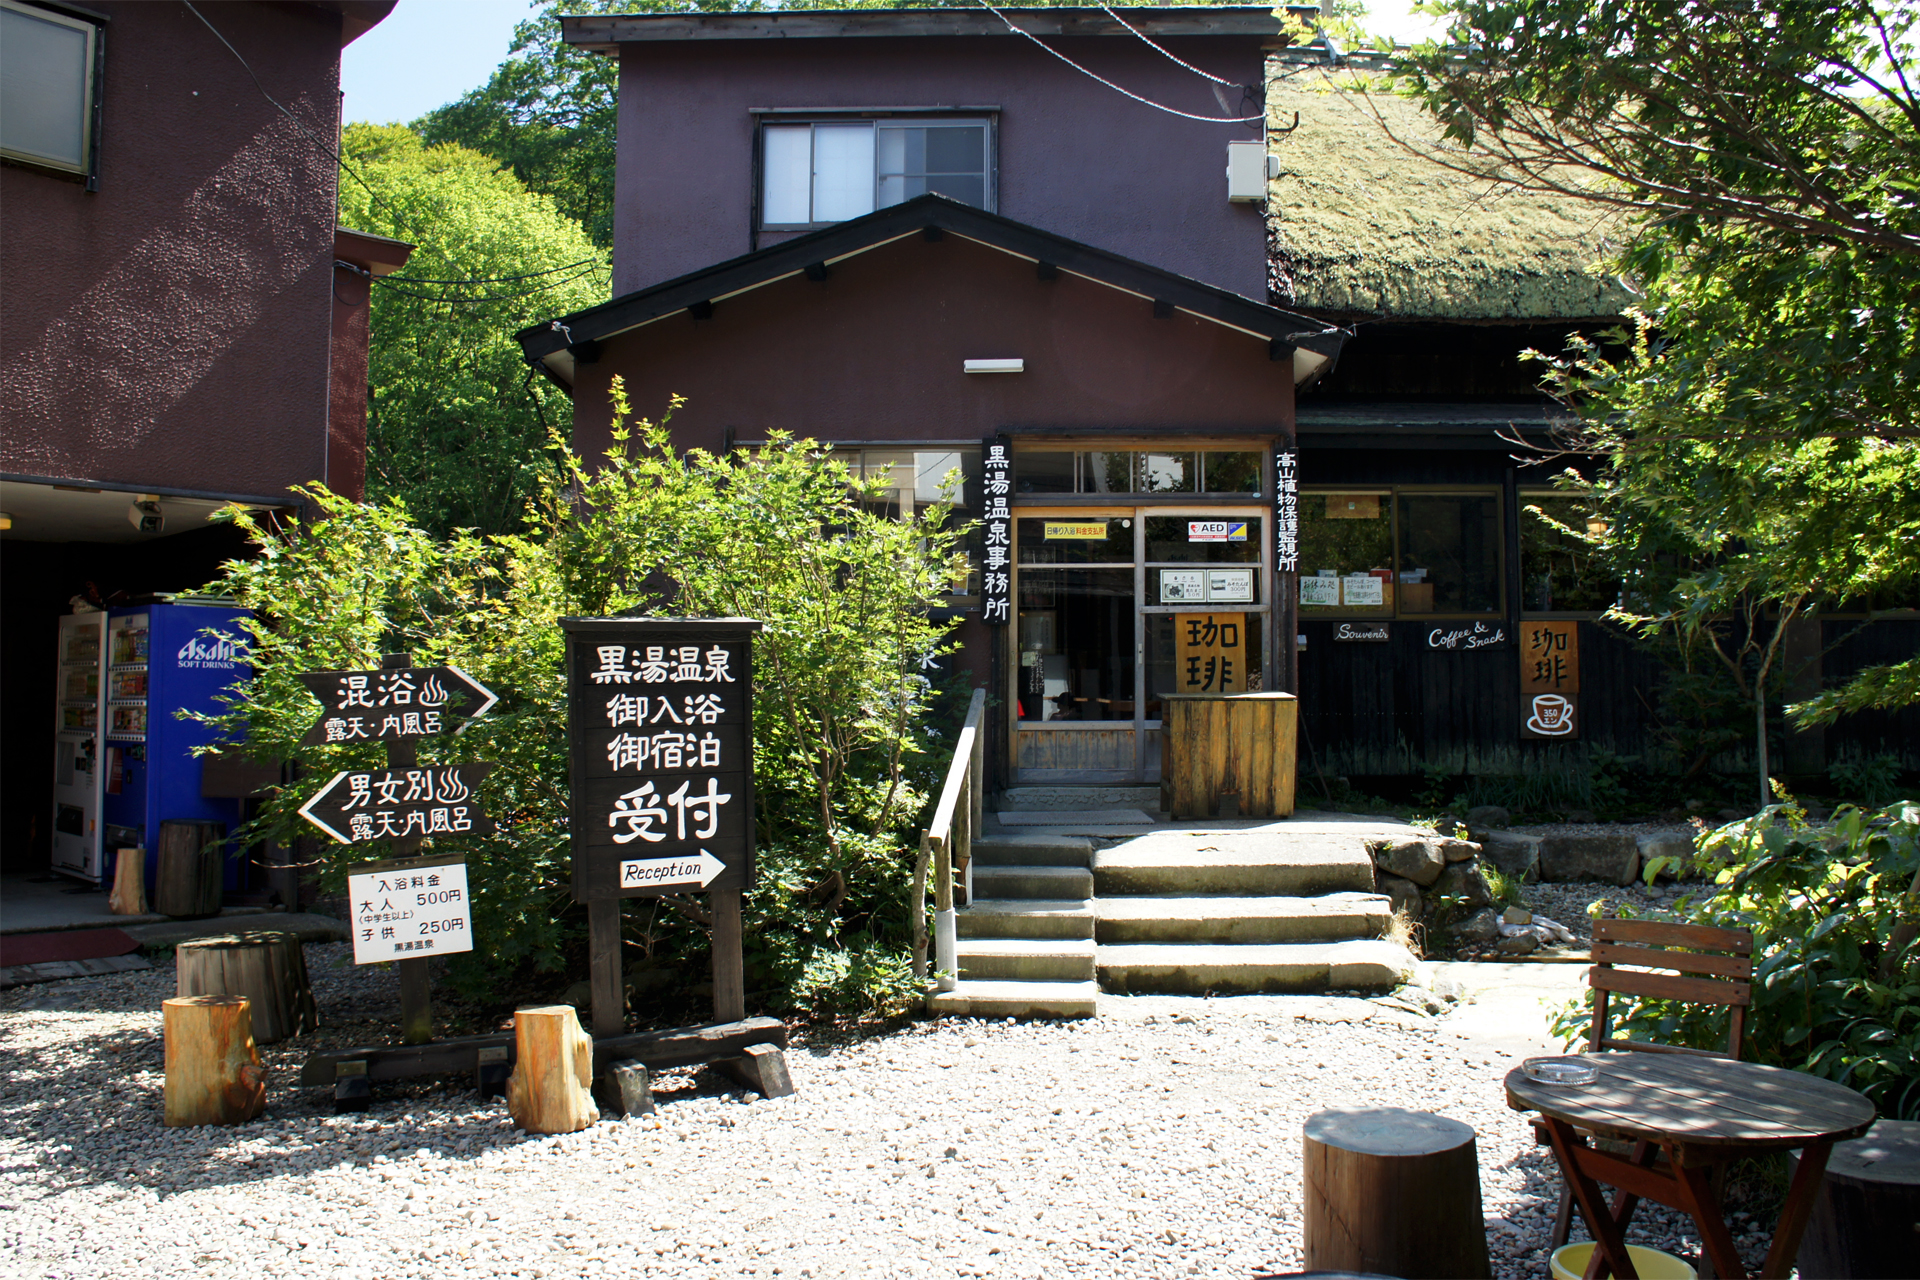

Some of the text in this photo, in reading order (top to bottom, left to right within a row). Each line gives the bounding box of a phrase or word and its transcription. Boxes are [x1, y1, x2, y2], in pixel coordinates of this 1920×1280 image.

[1276, 452, 1298, 571] 高山植物保護監視所
[984, 446, 1011, 620] 黒湯温泉事務所
[1202, 524, 1224, 532] AED
[1334, 624, 1389, 640] Souvenir
[1428, 621, 1489, 649] Coffee &
[1463, 629, 1505, 650] Snack
[178, 637, 236, 660] Asahi
[1187, 616, 1238, 692] 珈琲
[1532, 628, 1568, 688] 珈琲
[178, 660, 235, 669] SOFT DRINKS
[591, 645, 736, 684] 黒湯温泉
[337, 673, 416, 709] 混浴
[606, 693, 725, 728] 御入浴
[1543, 709, 1558, 717] 350
[325, 711, 441, 742] 露天・内風呂
[607, 730, 721, 771] 御宿泊
[341, 769, 433, 811] 男女別
[350, 807, 471, 842] 露天・内風呂
[609, 777, 731, 844] 受付
[378, 874, 440, 893] 入浴料金
[625, 862, 701, 881] Reception
[417, 889, 461, 906] 500円
[420, 917, 464, 935] 250円
[394, 939, 434, 953] 黒湯温泉
